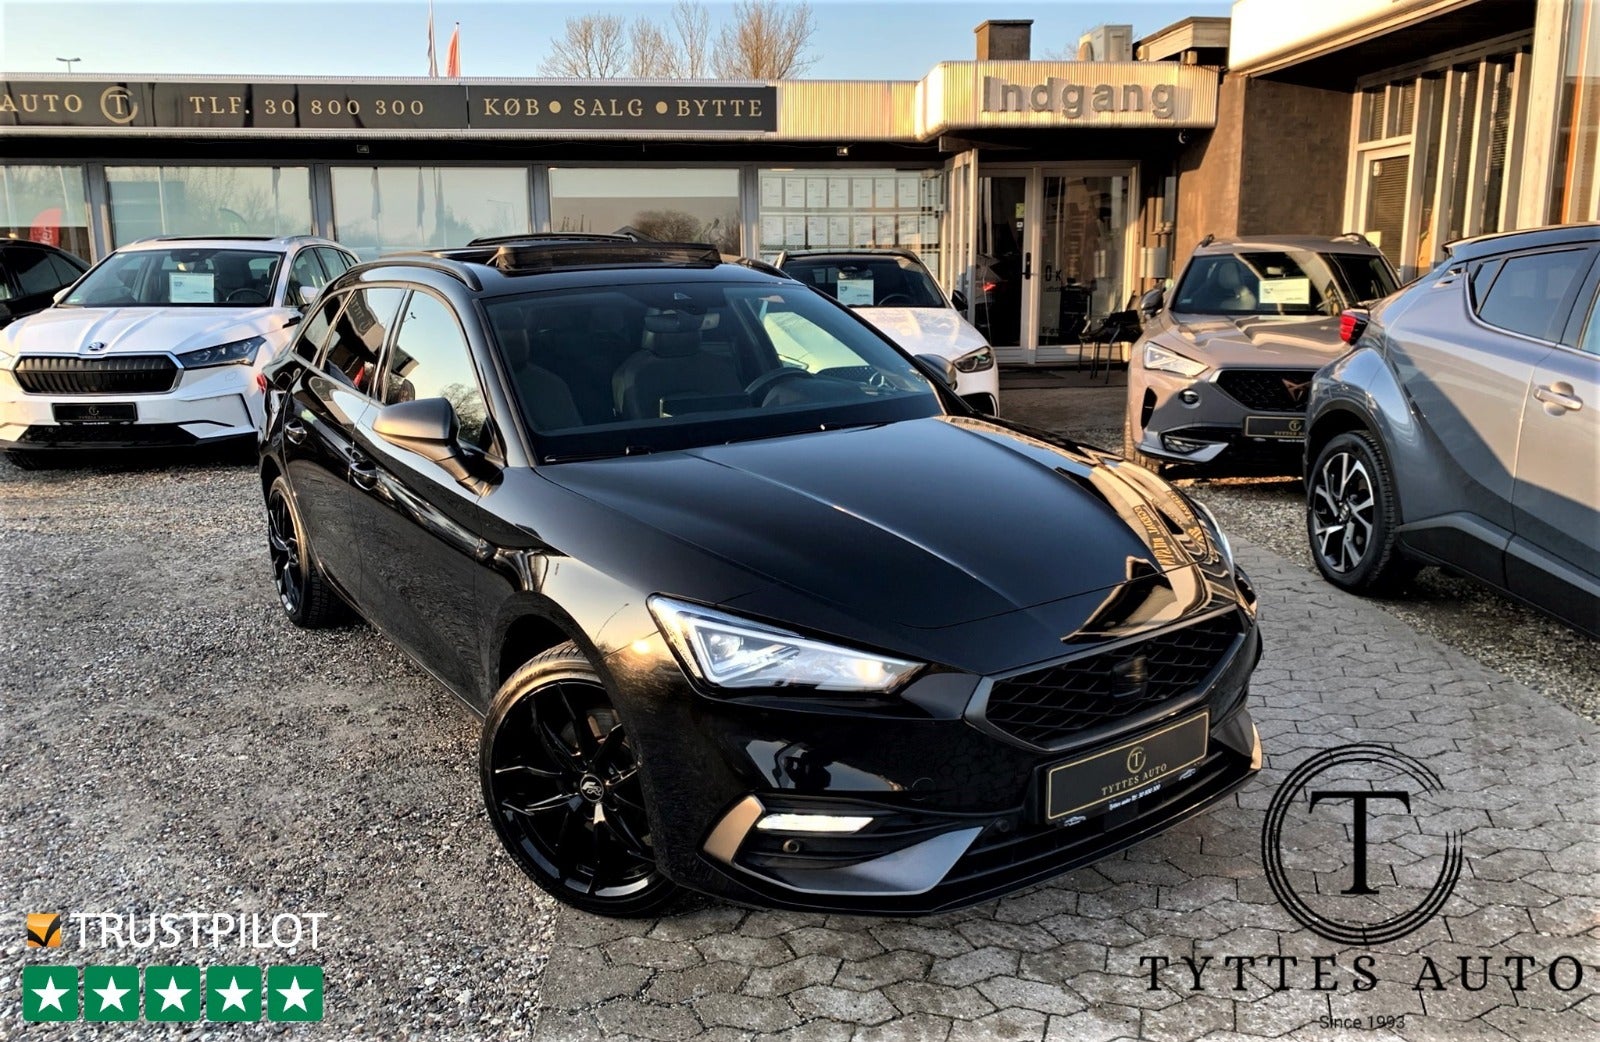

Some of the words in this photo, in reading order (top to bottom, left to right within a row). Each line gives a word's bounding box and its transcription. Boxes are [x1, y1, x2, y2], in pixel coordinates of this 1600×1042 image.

[0, 94, 82, 112] AUTO
[189, 96, 250, 114] TLF.
[265, 99, 296, 115] 30
[311, 99, 360, 115] 800
[375, 99, 424, 115] 300
[484, 98, 541, 116] KØB
[573, 98, 644, 117] SALG
[676, 99, 763, 118] BYTTE
[982, 76, 1175, 119] Indgang
[1101, 775, 1140, 796] TYTTES
[1143, 763, 1167, 781] AUTO
